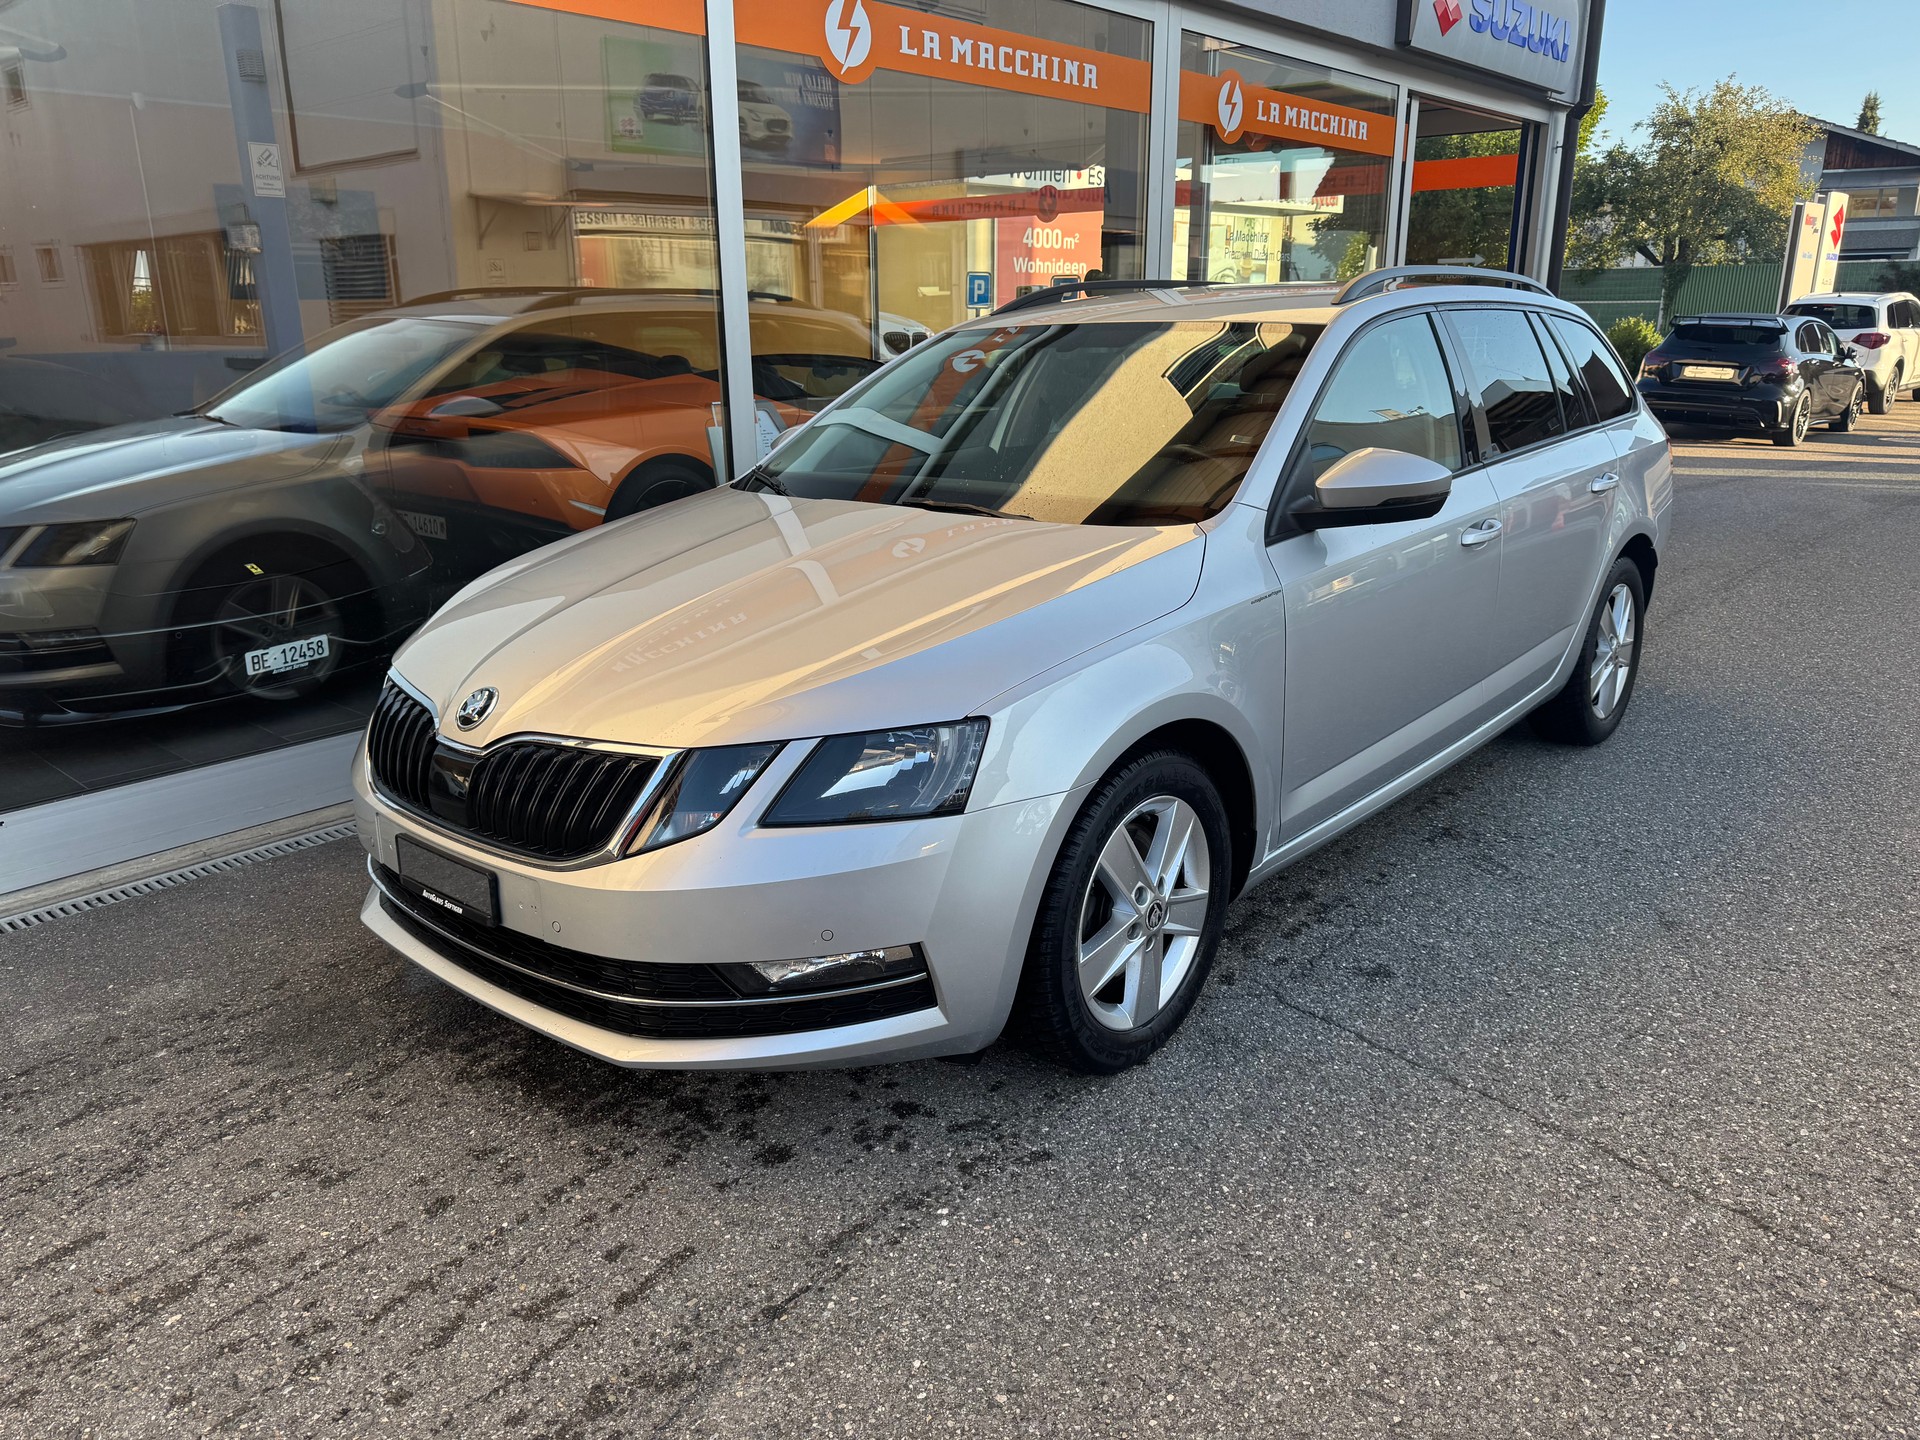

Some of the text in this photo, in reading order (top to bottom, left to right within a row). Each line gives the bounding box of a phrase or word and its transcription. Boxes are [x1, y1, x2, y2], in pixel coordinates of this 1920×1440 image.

[1469, 0, 1571, 62] SUZUKI
[899, 25, 1098, 89] LA MACCHINA
[1256, 99, 1368, 140] LA MACCHINA
[1023, 227, 1062, 250] 4000
[1013, 256, 1087, 275] Wohnideen
[974, 280, 985, 303] P
